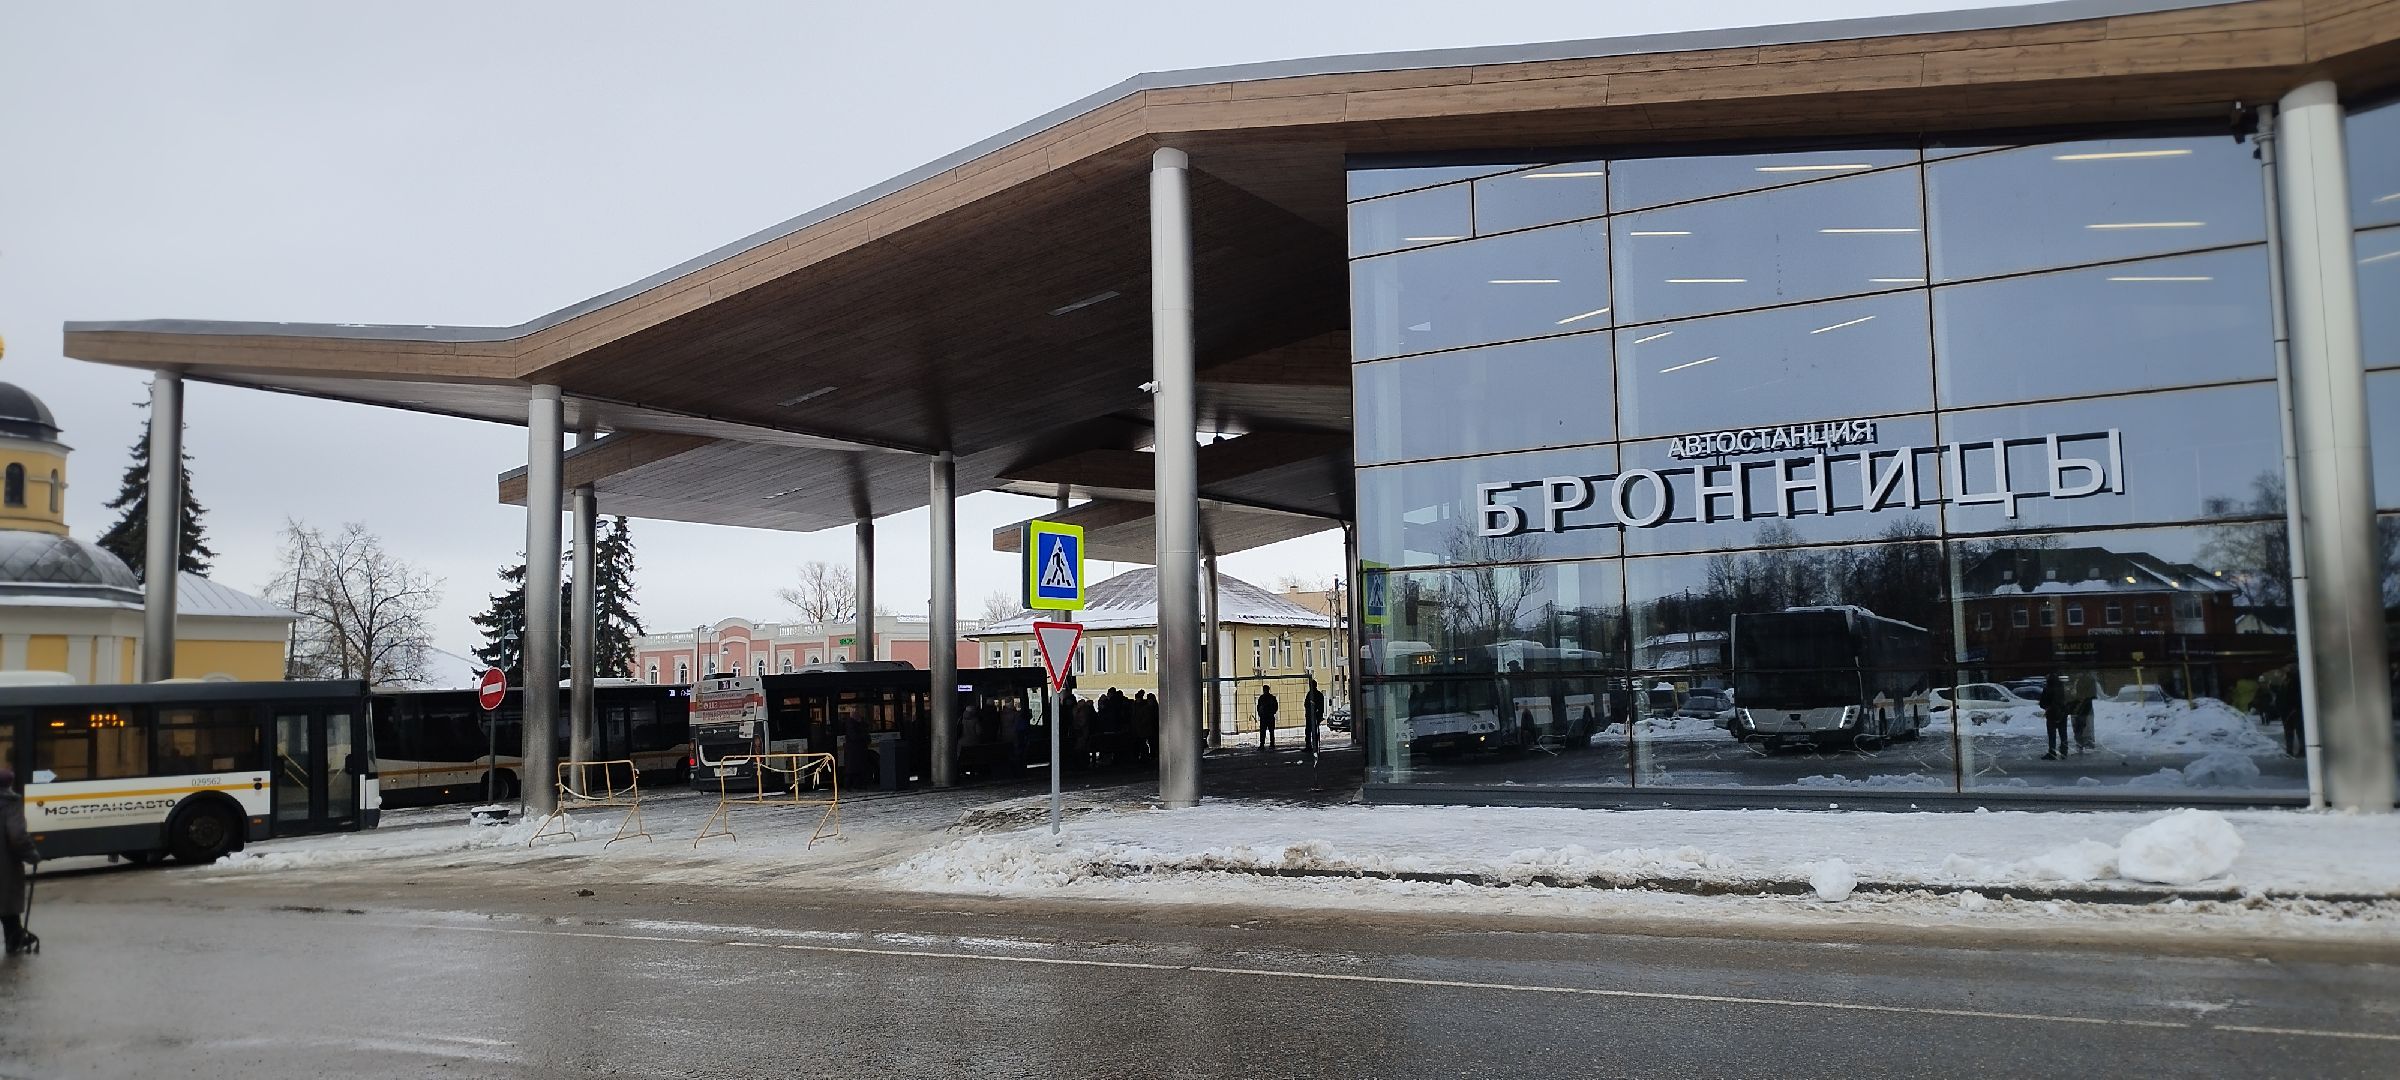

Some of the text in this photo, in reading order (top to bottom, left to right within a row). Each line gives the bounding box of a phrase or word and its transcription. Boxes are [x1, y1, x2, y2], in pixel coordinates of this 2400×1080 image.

[1667, 419, 1873, 458] АВТОСТАНЦИЯ
[1477, 428, 2125, 537] БРОННИЦЫ
[45, 799, 176, 816] МОСТРАНСАВТО
